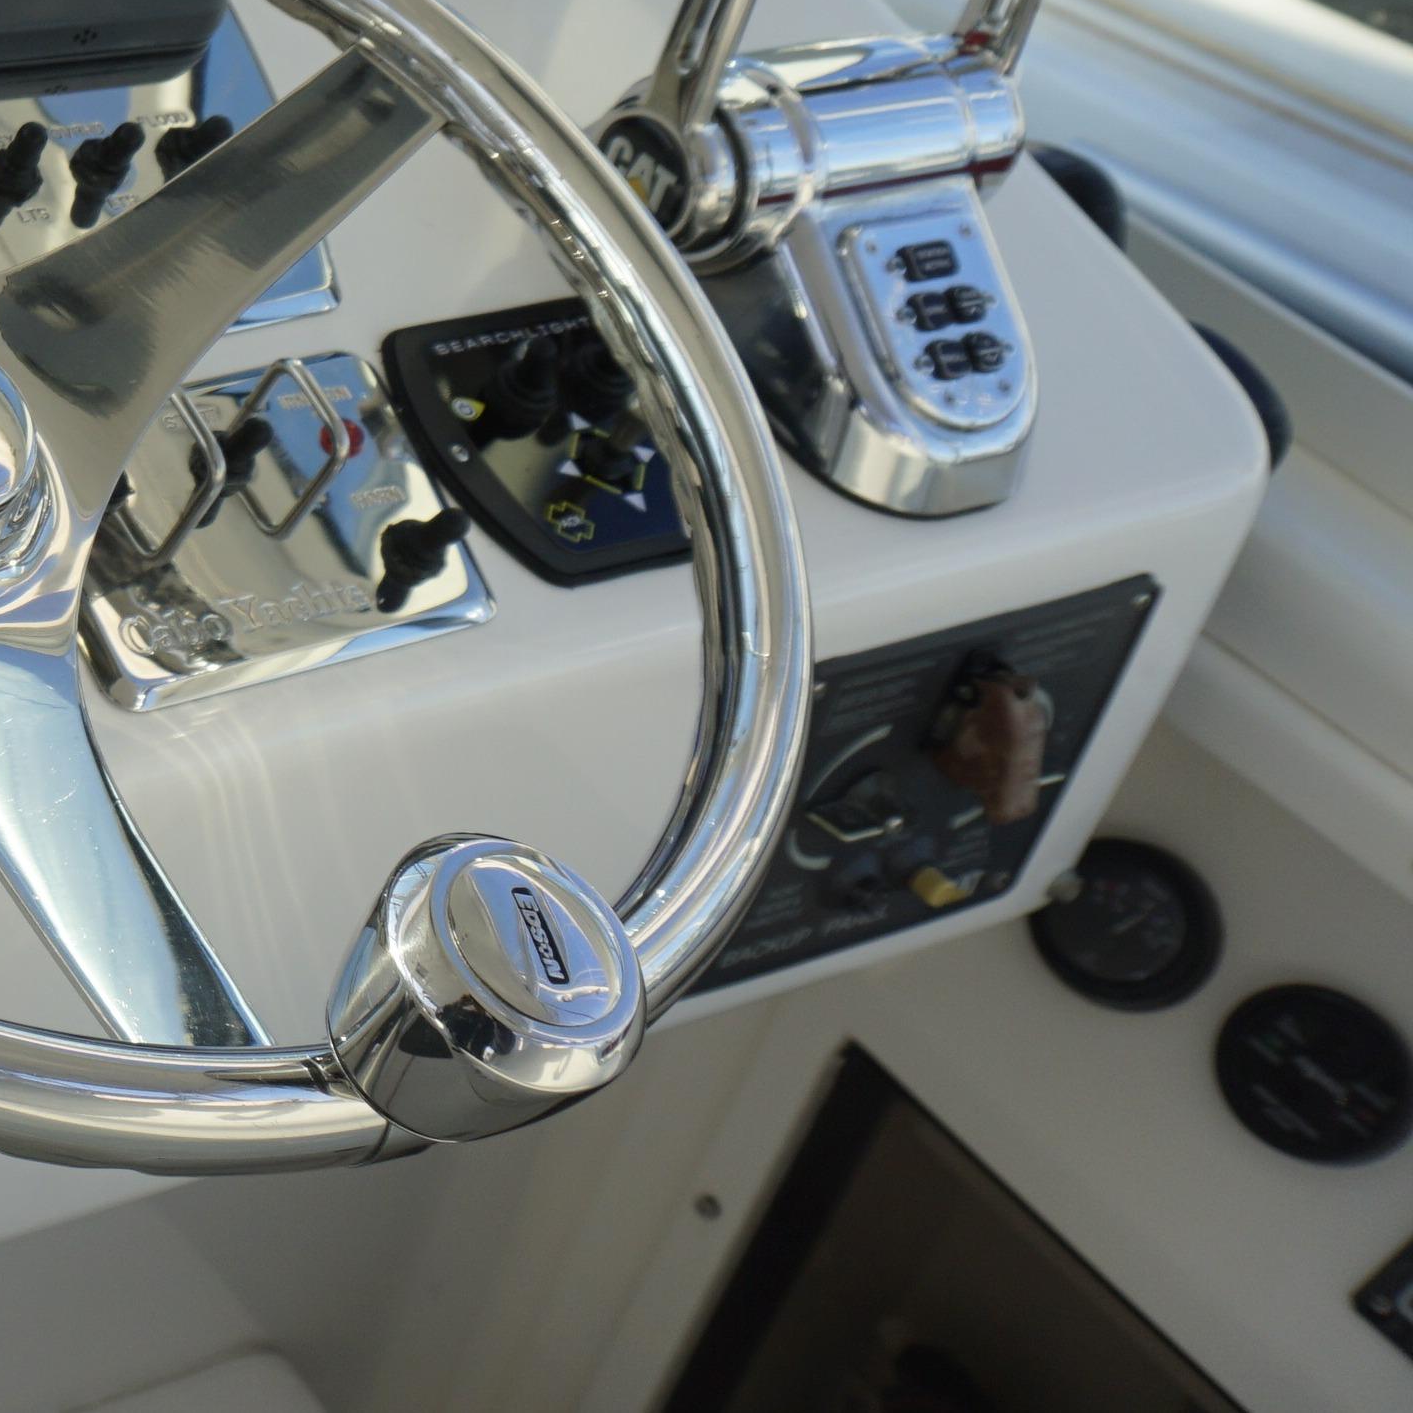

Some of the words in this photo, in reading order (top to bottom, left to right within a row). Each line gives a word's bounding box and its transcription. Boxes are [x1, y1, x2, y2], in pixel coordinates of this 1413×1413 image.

[607, 135, 678, 214] CAT
[18, 207, 50, 223] LTS
[435, 315, 590, 355] SEARCHLIGHT
[119, 608, 228, 655] Cabo
[215, 583, 371, 634] Yachts
[514, 892, 566, 980] EDSON
